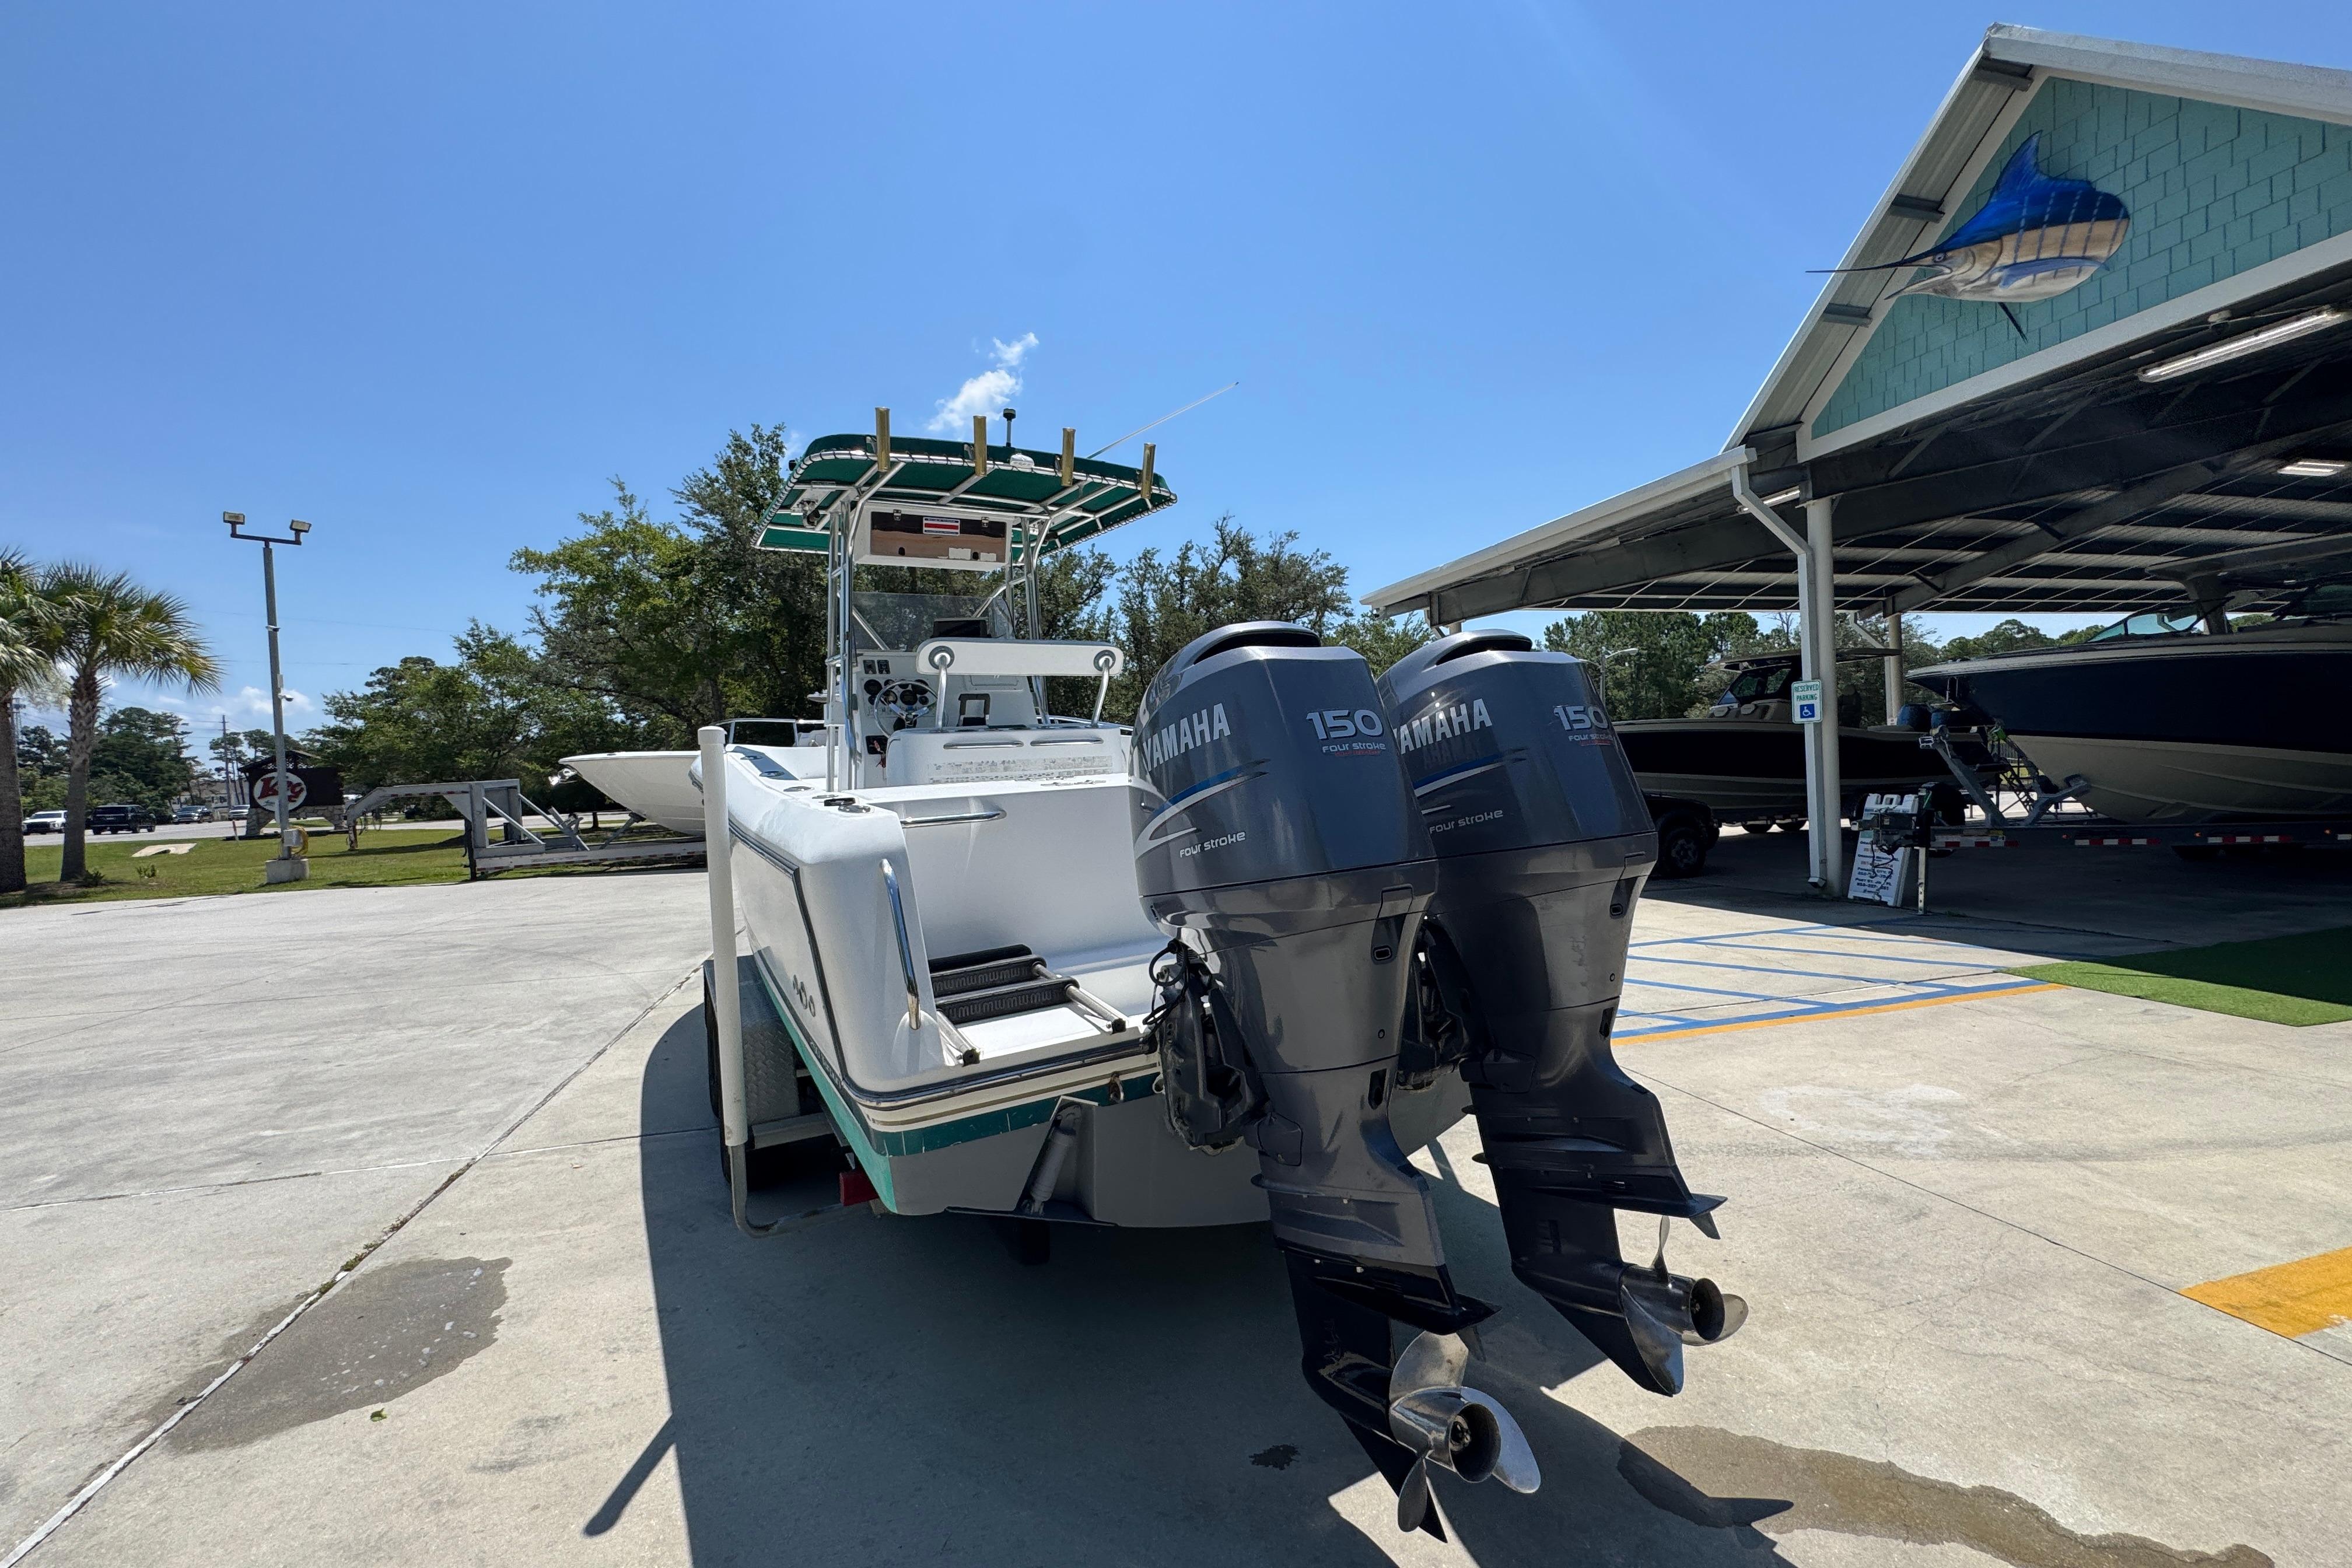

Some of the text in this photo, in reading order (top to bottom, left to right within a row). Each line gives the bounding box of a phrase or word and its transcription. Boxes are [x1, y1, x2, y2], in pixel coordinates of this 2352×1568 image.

[1794, 684, 1819, 692] RESERVED
[1306, 709, 1385, 740] 150
[1553, 705, 1609, 730] 150
[1143, 703, 1231, 772] YAMAHA
